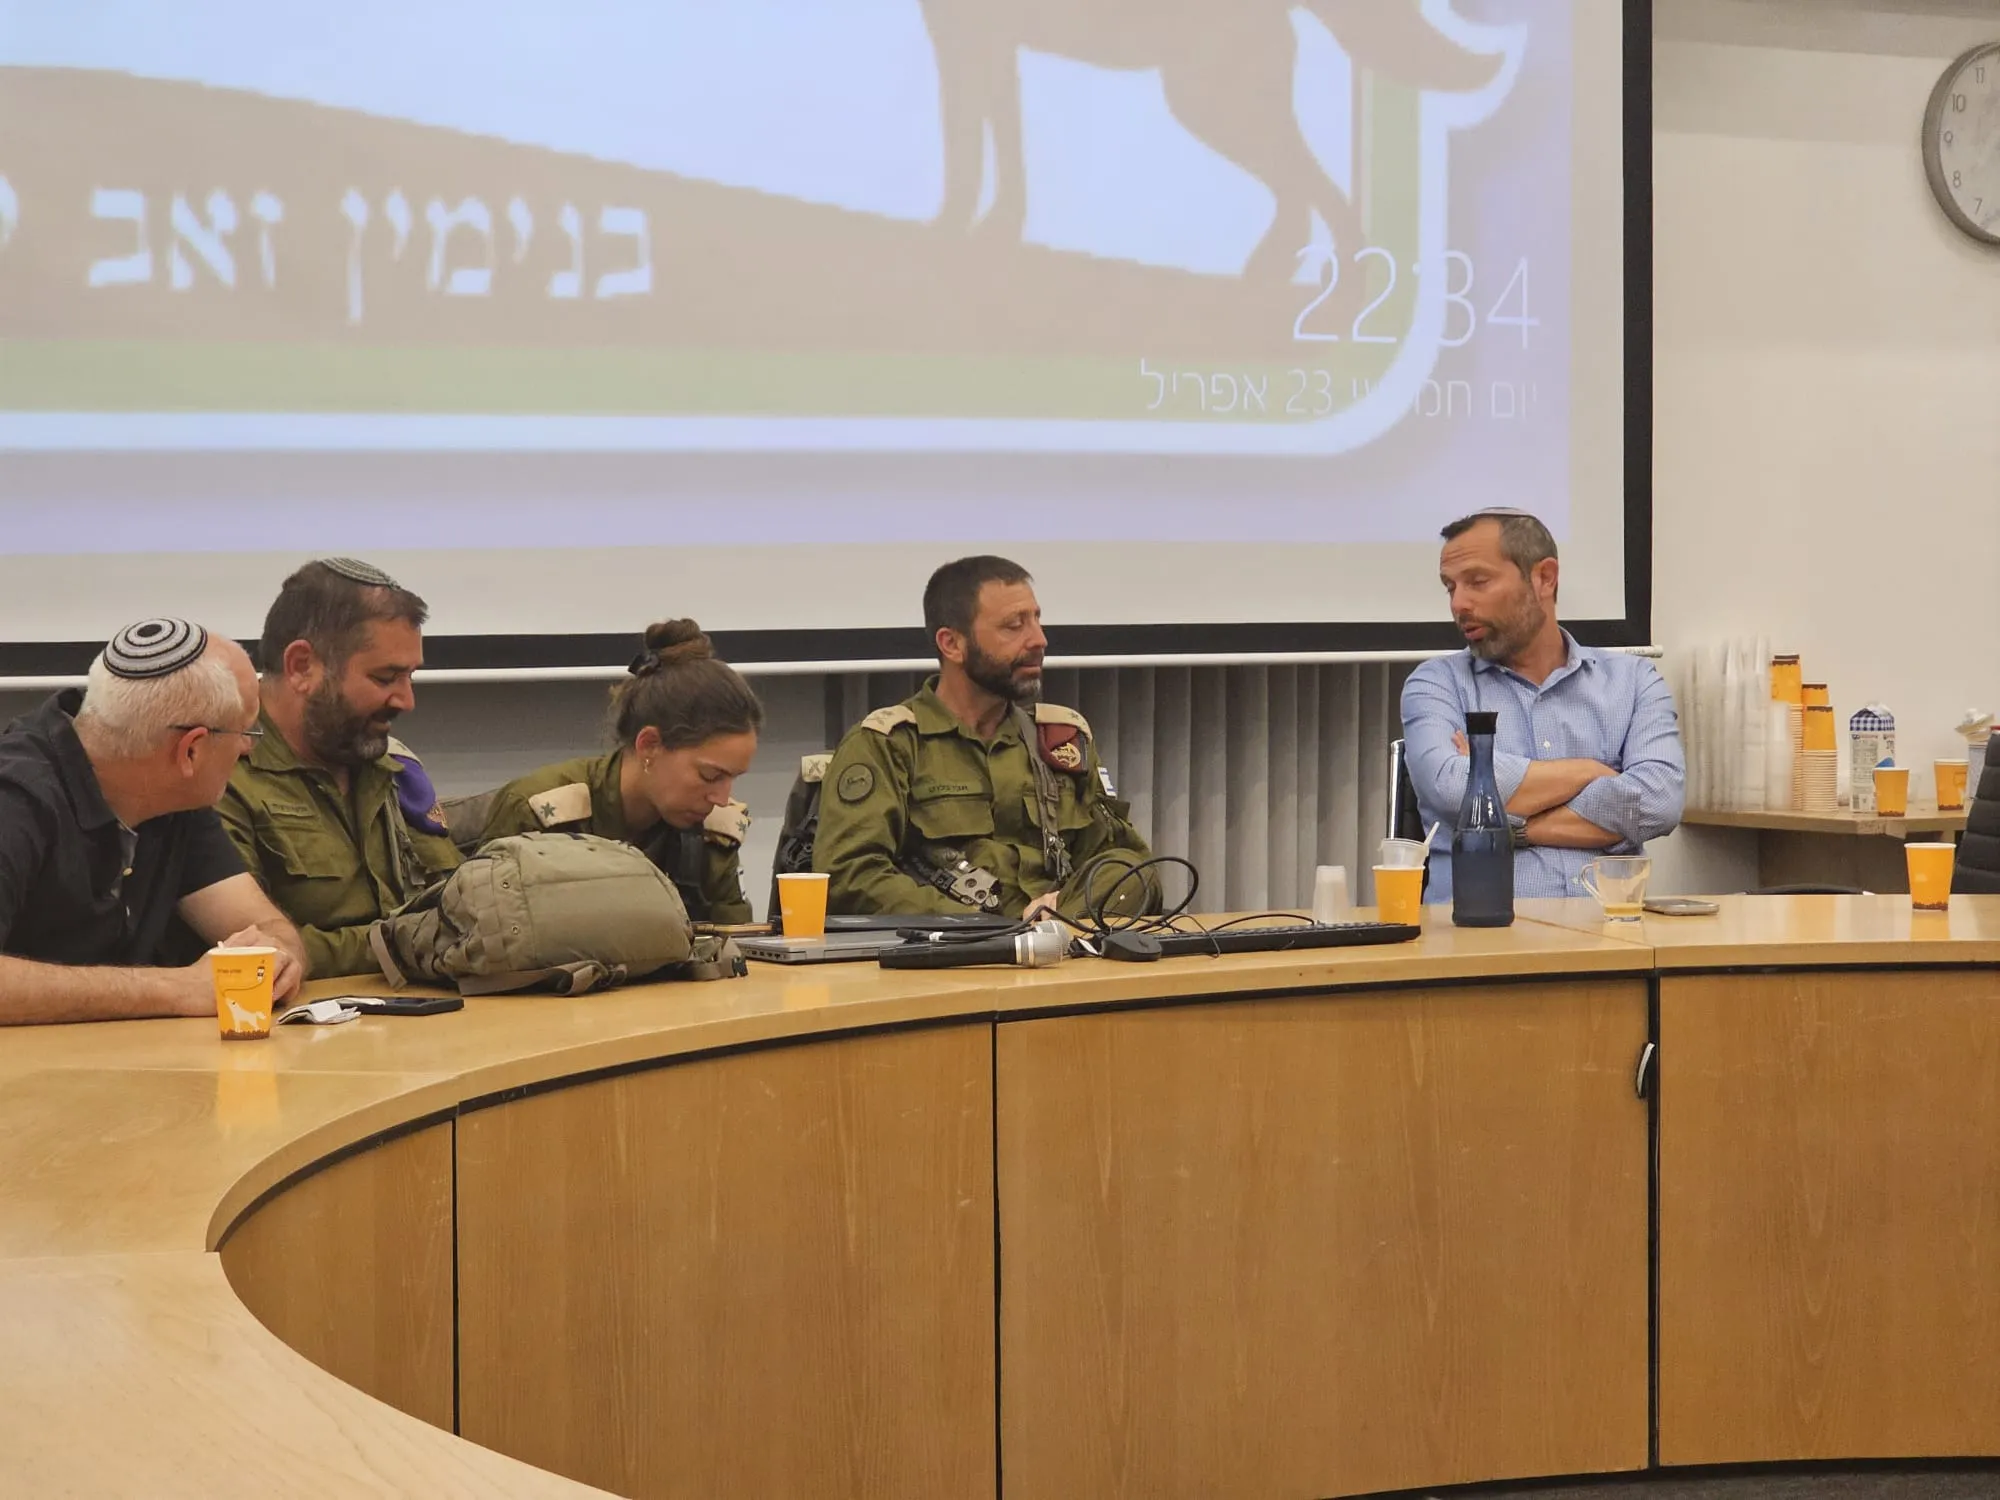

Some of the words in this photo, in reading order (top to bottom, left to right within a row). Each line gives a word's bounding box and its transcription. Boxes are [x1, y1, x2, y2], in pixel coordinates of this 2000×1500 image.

[1952, 93, 1966, 112] 10
[1953, 170, 1962, 188] 8
[1974, 197, 1983, 215] 7
[87, 186, 285, 292] זאב
[338, 185, 654, 326] בנימין
[1140, 357, 1268, 414] אפריל
[1285, 368, 1333, 415] 23
[1351, 377, 1472, 418] חמי
[1490, 379, 1538, 419] יום
